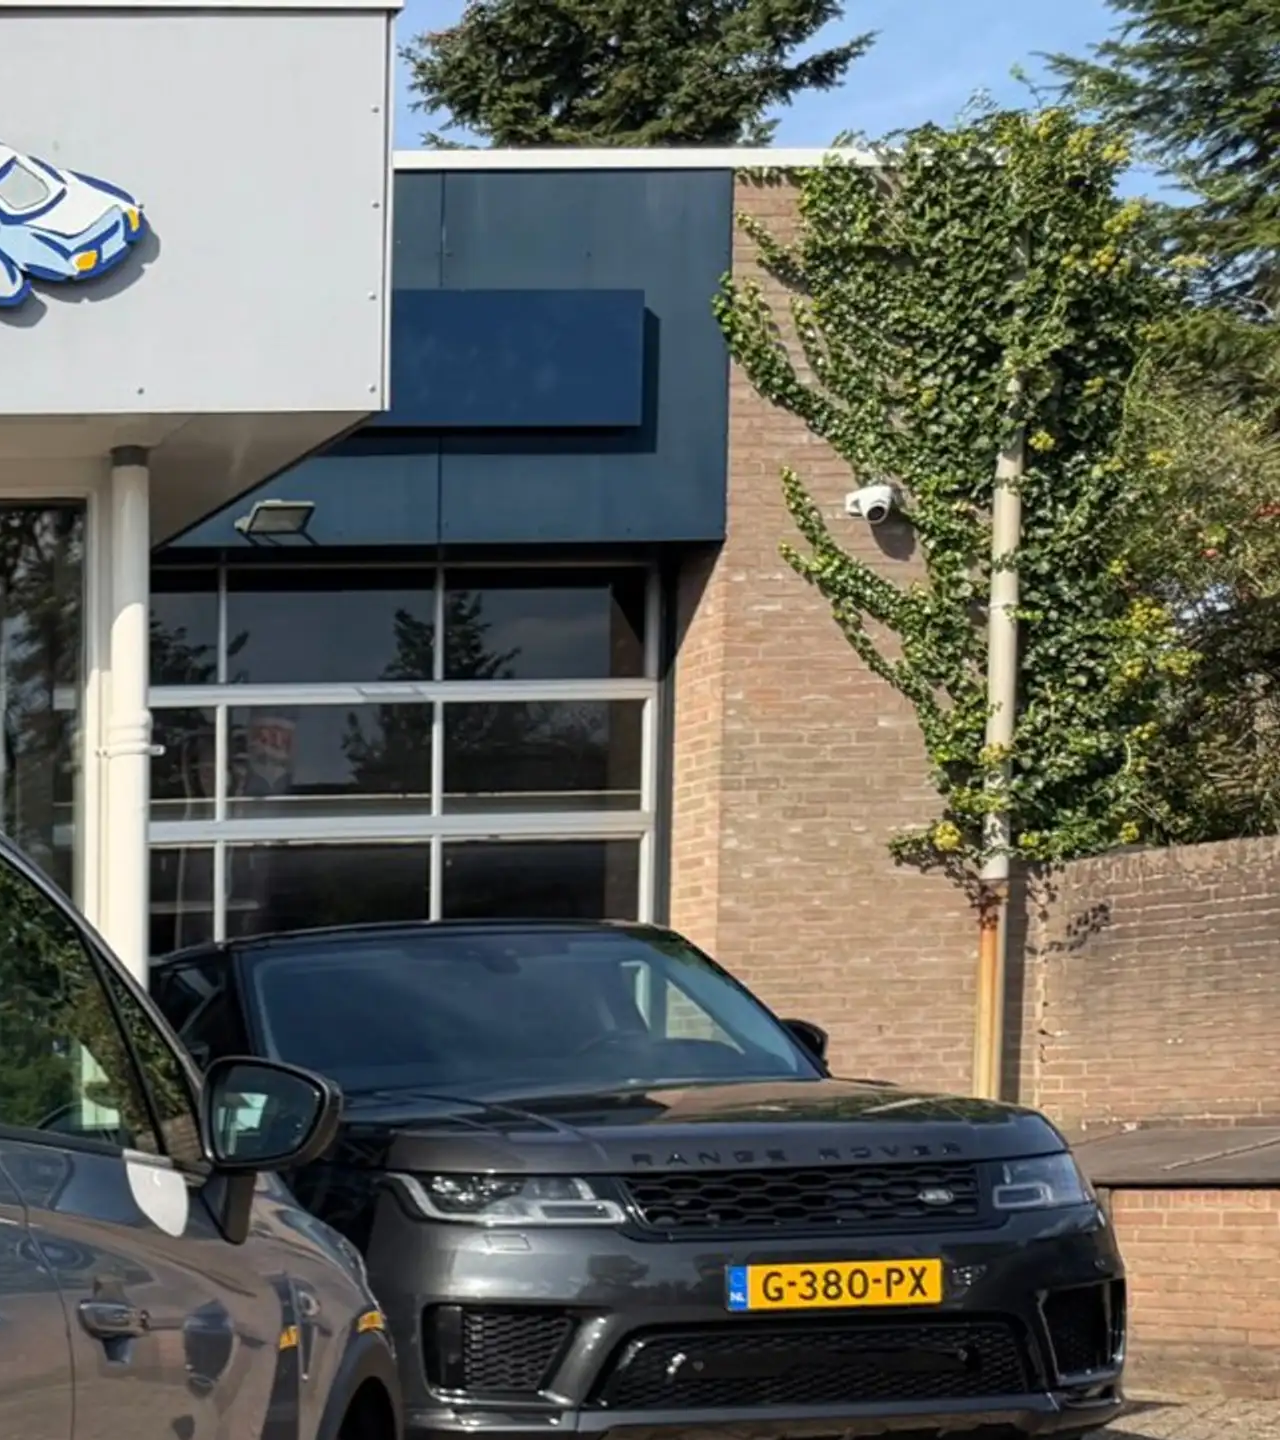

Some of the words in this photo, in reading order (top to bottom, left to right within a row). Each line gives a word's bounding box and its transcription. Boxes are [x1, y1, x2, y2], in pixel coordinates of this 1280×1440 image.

[630, 1149, 787, 1167] RANGE
[820, 1142, 962, 1161] ROVER
[761, 1265, 928, 1302] G-380-PX
